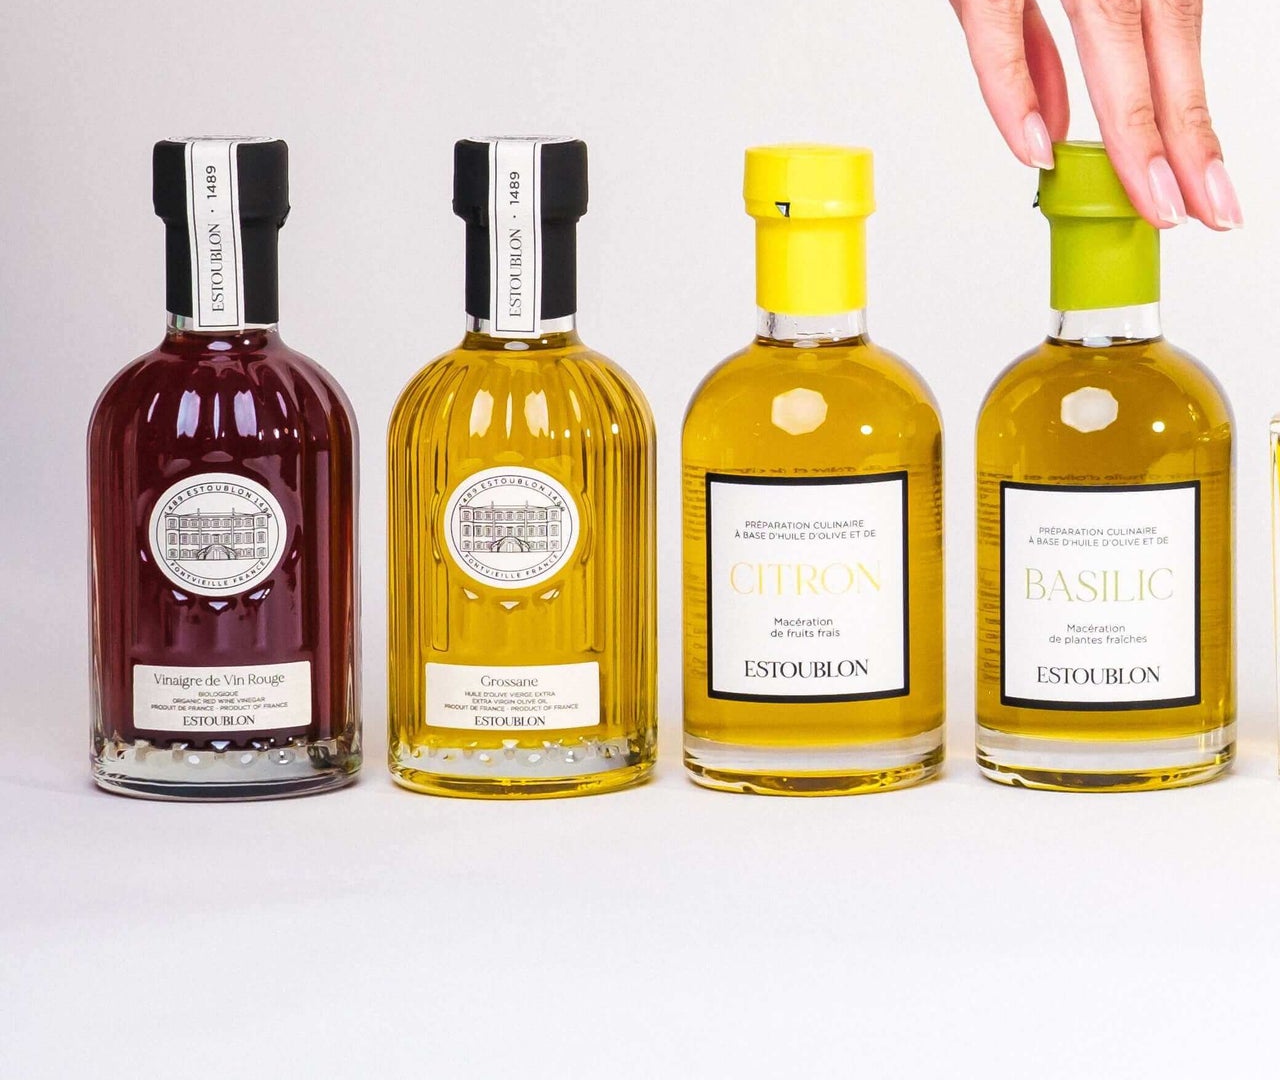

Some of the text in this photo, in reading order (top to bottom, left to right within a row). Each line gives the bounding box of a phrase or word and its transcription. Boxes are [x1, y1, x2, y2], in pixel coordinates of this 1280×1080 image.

[206, 165, 224, 311] ESTOUBLON 1489
[509, 172, 522, 317] ESTOUBLON 1489
[481, 478, 545, 492] ESTOUBLON
[187, 485, 251, 498] ESTOUBLON
[745, 520, 864, 530] PRÉPARATION CULINAIRE
[1039, 526, 1157, 536] PRÉPARATION CULINAIRE
[734, 529, 876, 540] À BASE D'HUILE D'OLIVE ET DE
[1029, 536, 1169, 547] À BASE D'HUILE D'OLIVE ET DE
[464, 554, 558, 578] FONTVIEILLE FRANCE
[170, 561, 266, 586] FONTVIEILLE FRANCE
[729, 560, 881, 595] CITRON
[1025, 568, 1174, 602] BASILIC
[774, 617, 833, 627] Macération
[771, 629, 840, 638] de fruits frais
[1067, 624, 1125, 633] Macération
[1049, 634, 1147, 645] de plantes fraîches
[745, 659, 869, 678] ESTOUBLON
[154, 673, 285, 688] Vinaigre de Vin Rouge
[481, 675, 538, 687] Grossane
[1037, 666, 1160, 685] ESTOUBLON
[183, 715, 255, 726] ESTOUBLON
[475, 716, 545, 727] ESTOUBLON
